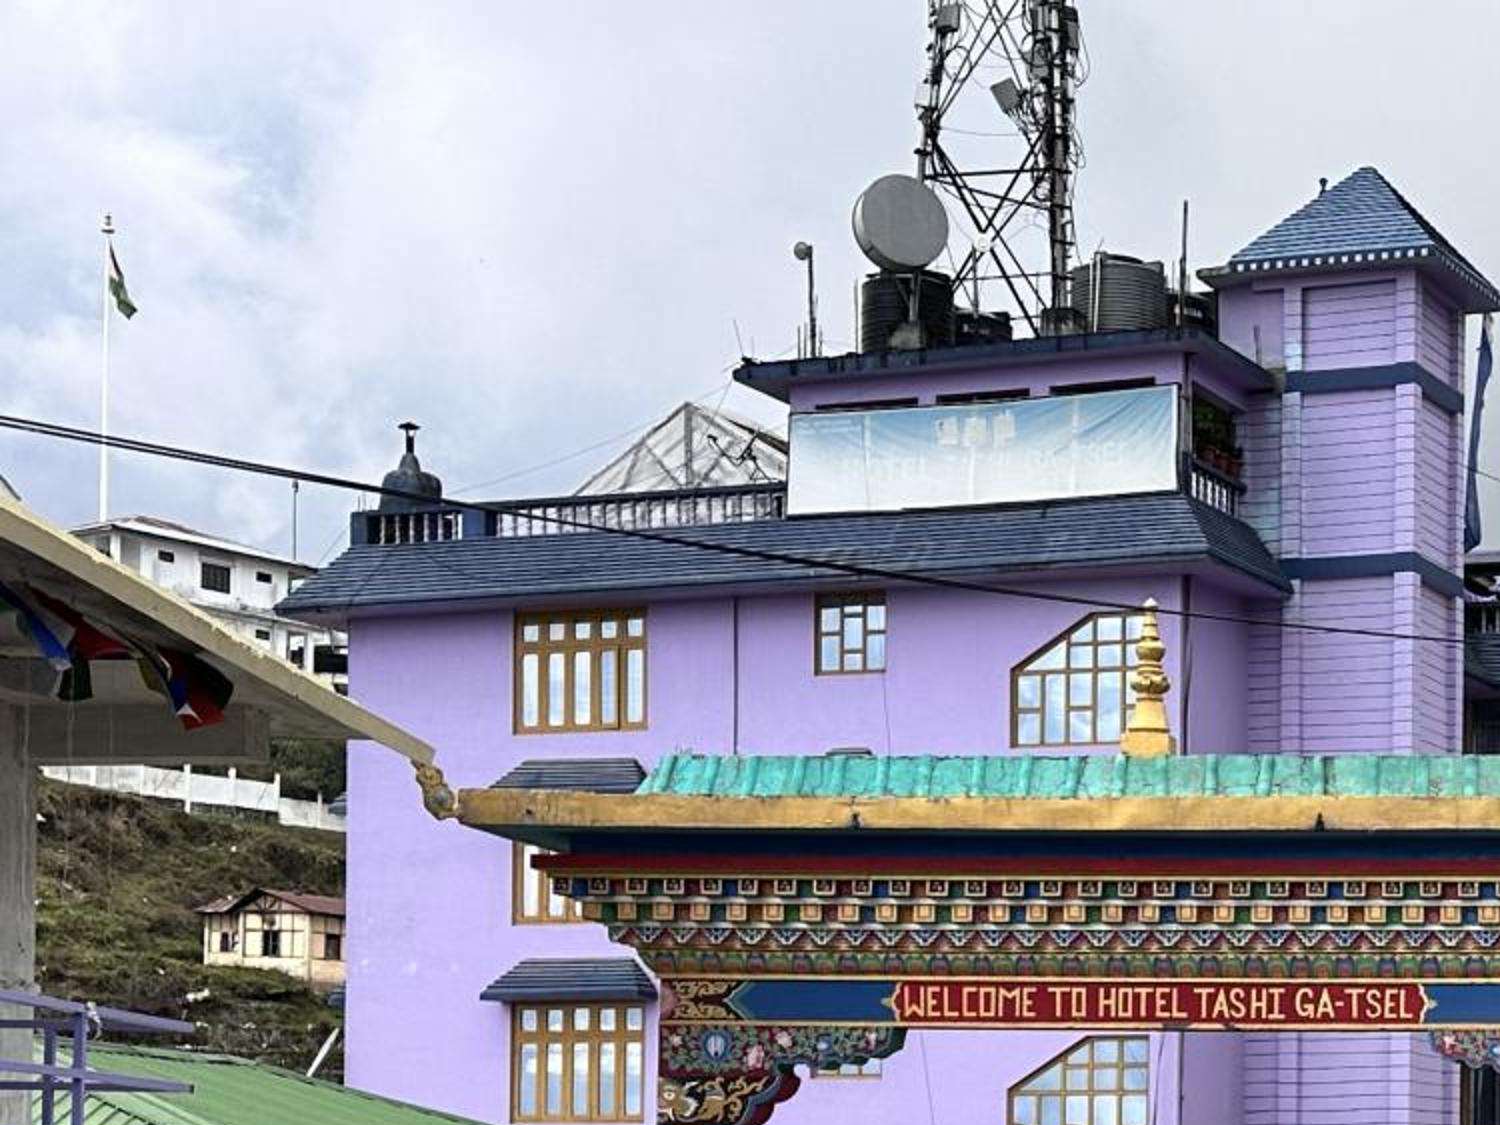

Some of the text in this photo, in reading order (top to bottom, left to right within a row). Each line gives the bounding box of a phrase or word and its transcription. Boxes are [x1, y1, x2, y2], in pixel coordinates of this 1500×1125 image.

[903, 985, 1413, 1019] WELCOME TO HOTEL TASHI GA-TSEL
